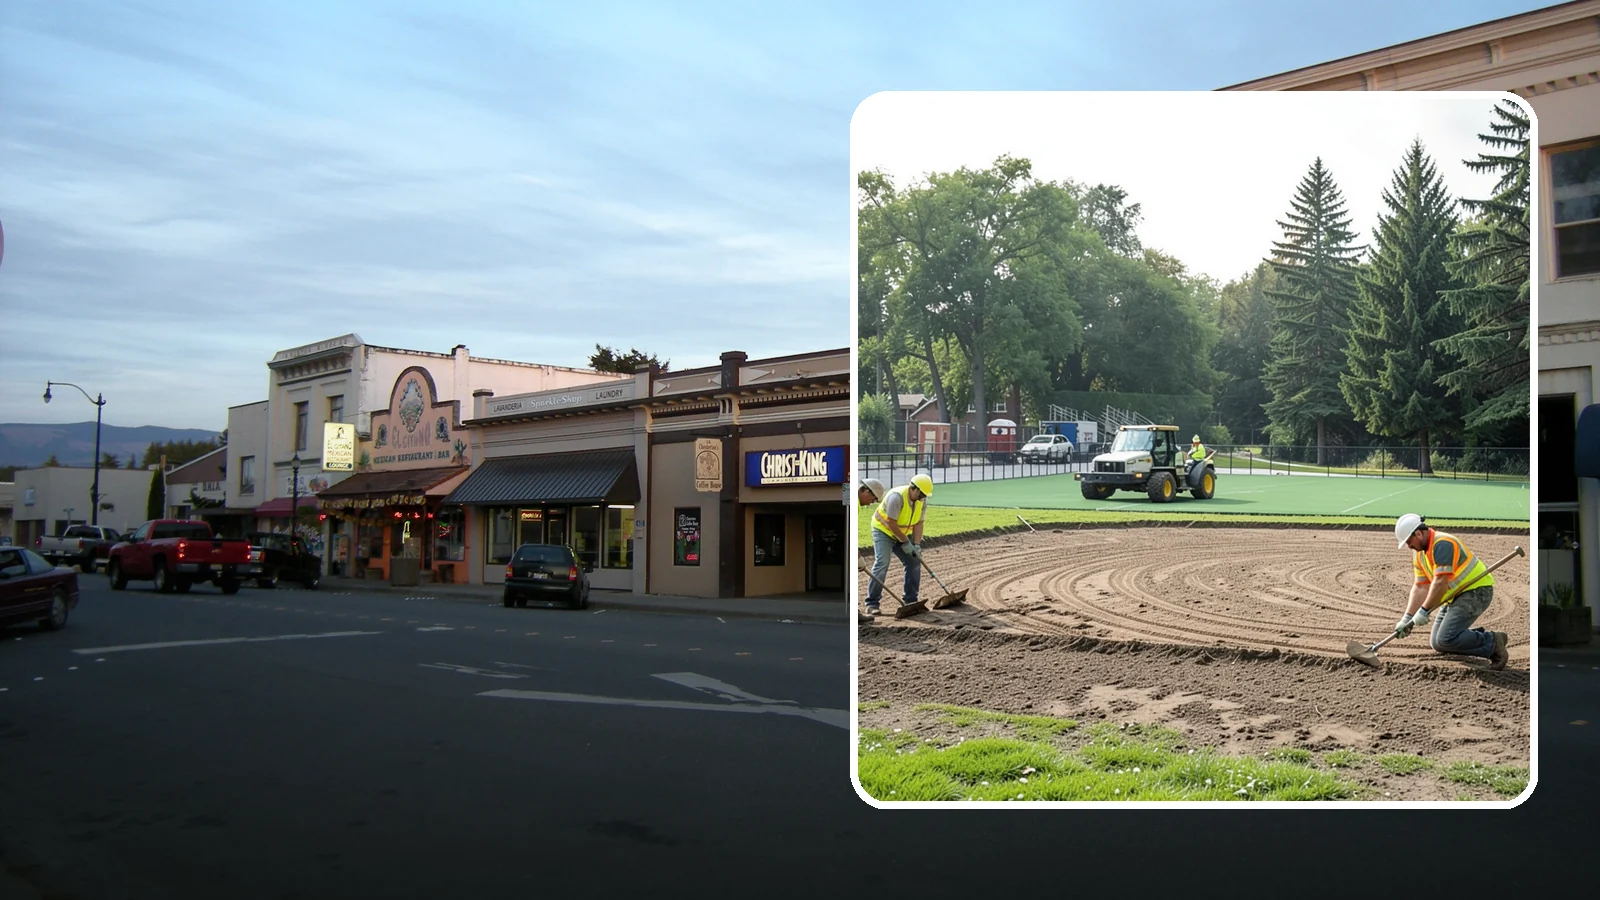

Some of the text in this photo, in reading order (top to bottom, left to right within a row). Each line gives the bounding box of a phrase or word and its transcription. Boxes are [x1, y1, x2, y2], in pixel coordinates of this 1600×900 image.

[561, 394, 582, 404] Shop
[595, 389, 623, 400] LAUNDRY
[494, 402, 522, 412] LAVANDERIA
[373, 455, 396, 464] MEXICAN
[397, 452, 433, 462] RESTAURANT
[438, 450, 450, 459] BAR
[761, 450, 828, 478] CHRIST KING
